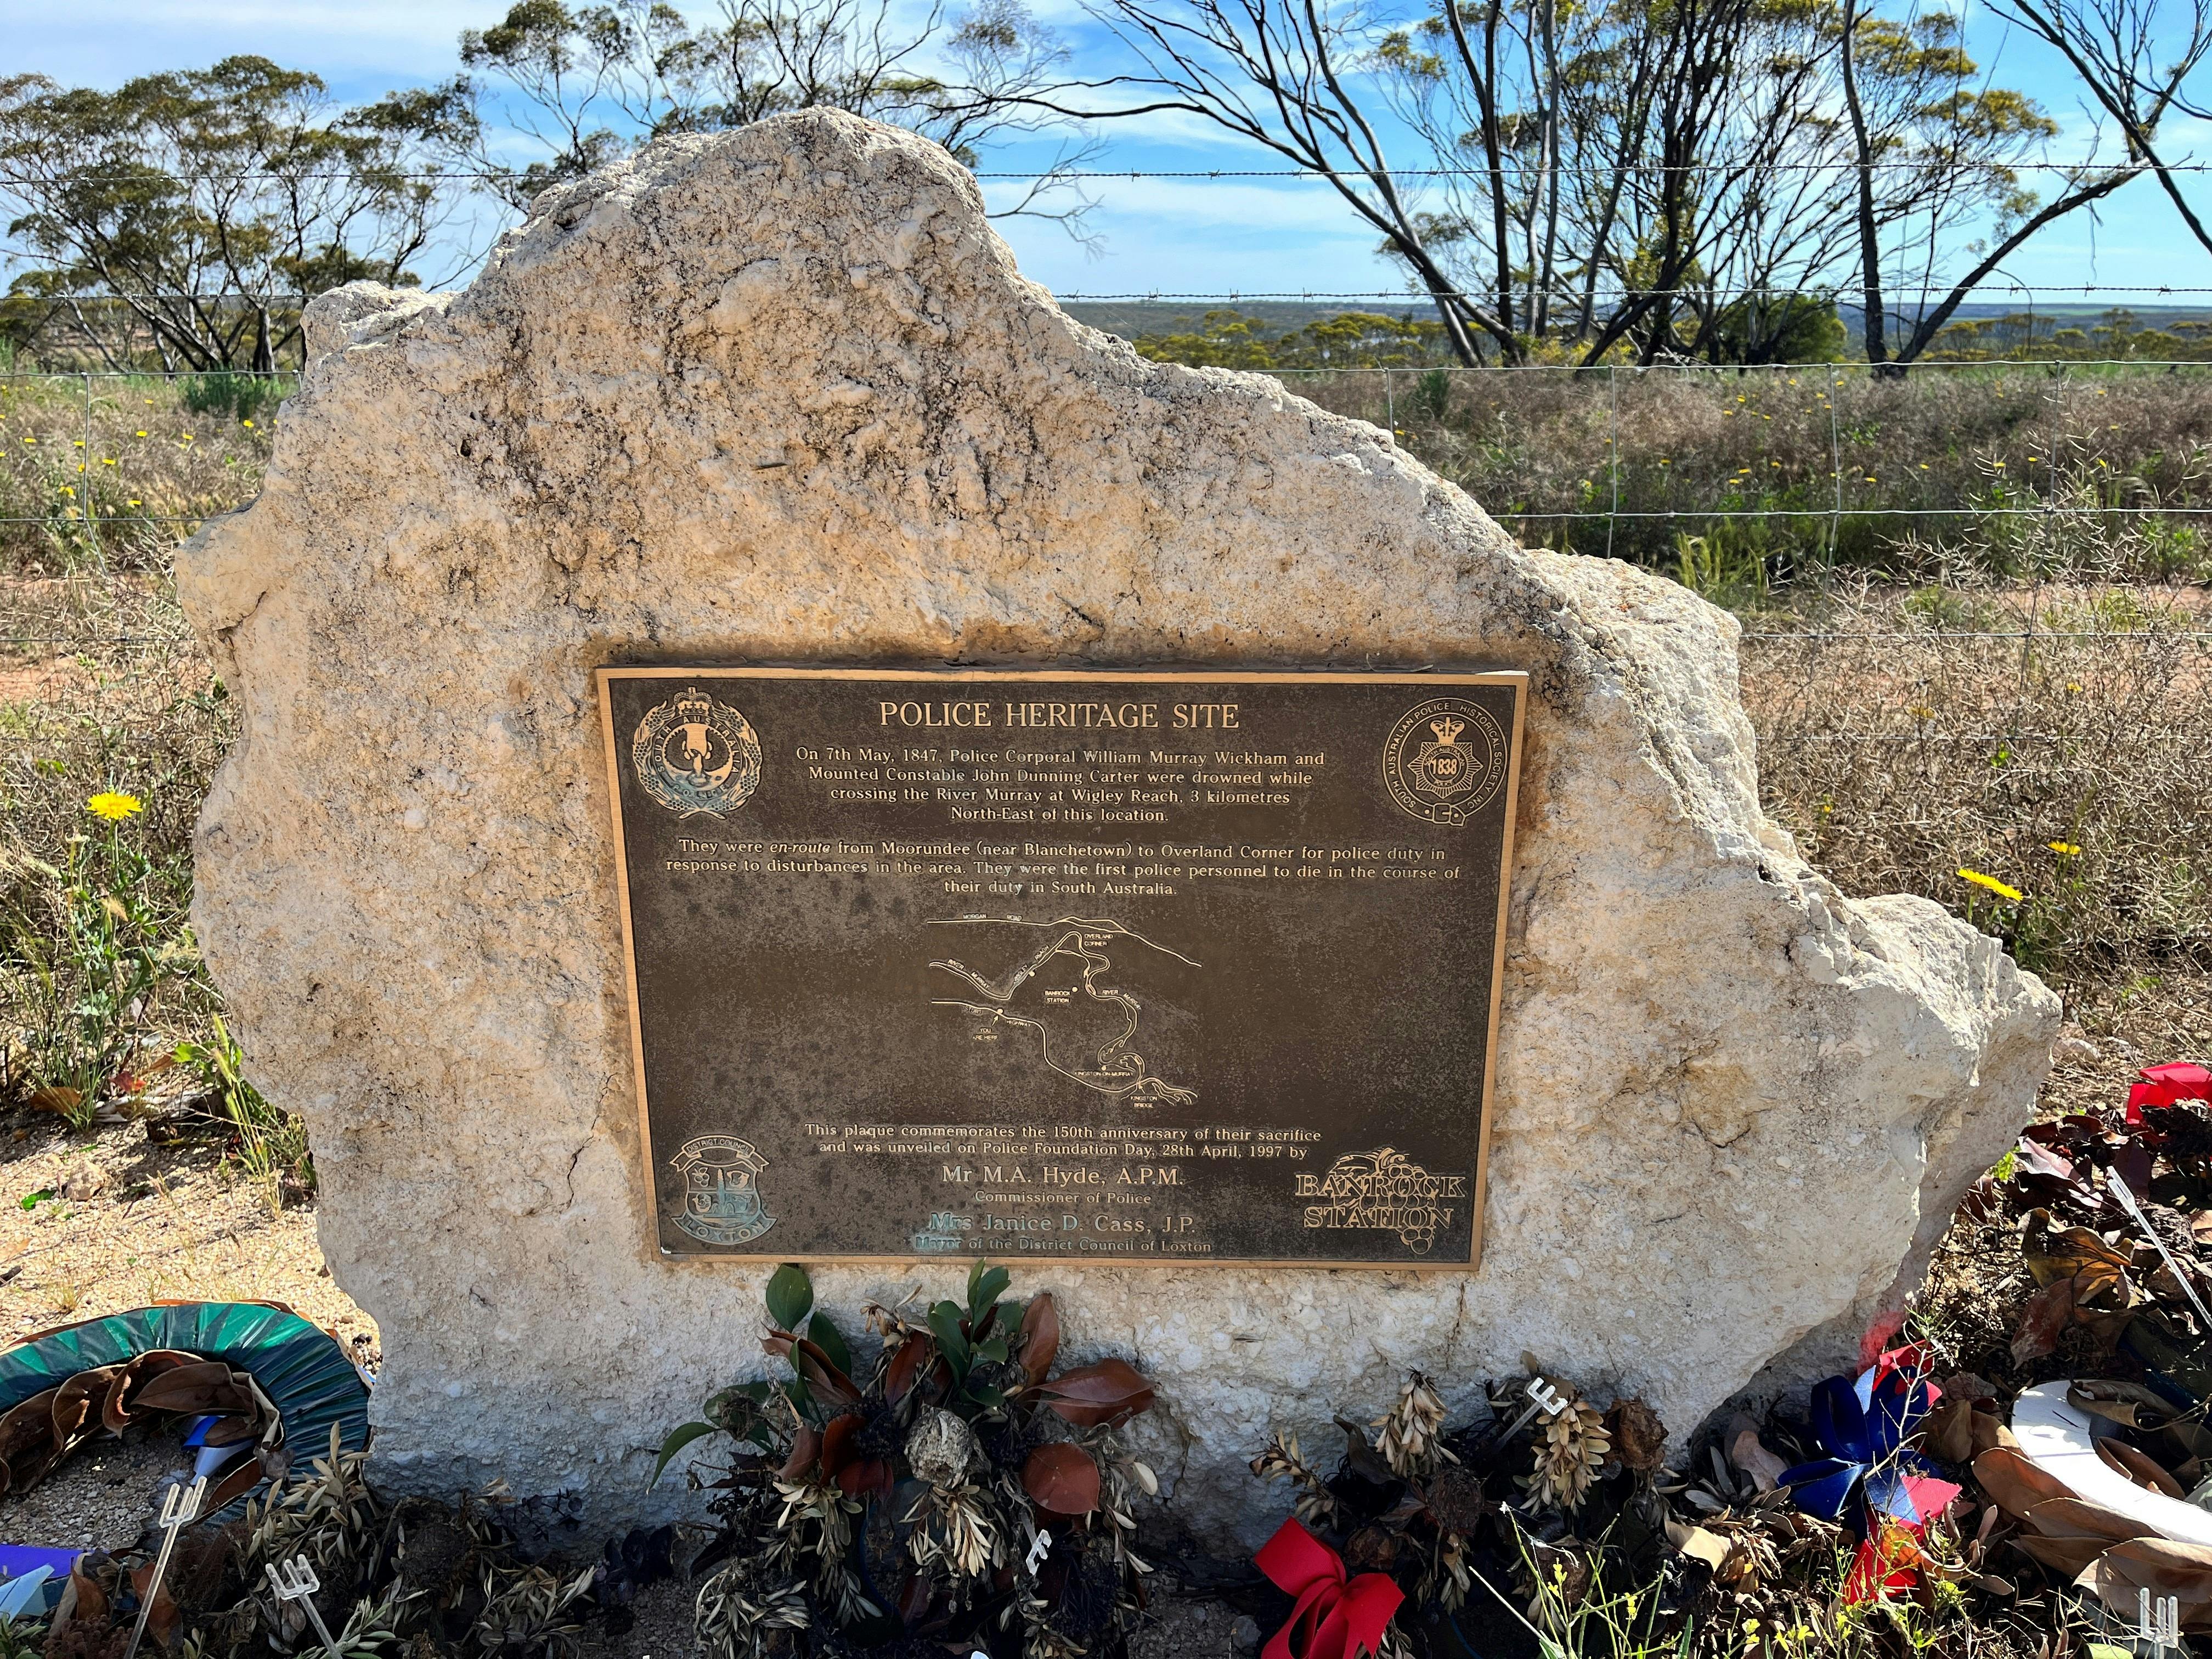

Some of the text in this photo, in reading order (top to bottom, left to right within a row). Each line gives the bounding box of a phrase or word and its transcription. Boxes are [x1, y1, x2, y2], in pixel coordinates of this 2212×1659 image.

[879, 702, 1239, 728] POLICE HERITAGE SITE
[654, 715, 741, 773] SOUTH AUSTRALIA
[796, 747, 1324, 767] On 7th May, 1847, Police Corporal William Murray Wickham and
[1388, 702, 1503, 809] SOUTH AUSTRALIAN POLICE HISTORICAL SOCIETY INC
[809, 766, 1312, 785] Mounted Constable John Dunning Carter were drowned while
[1431, 758, 1458, 775] 1838
[830, 787, 1290, 805] crossing the River Murray at Wigley Reach, 3 kilometres
[951, 806, 1169, 822] North-East of this location.
[678, 839, 1445, 863] They were en-route from Moorundee (near Blanchetown) to Overland Corner for police duty in
[666, 859, 1460, 879] response to disturbances in the area. They were the first police personnel to die in the course of
[945, 880, 1178, 895] their duty in South Australia.
[947, 959, 990, 989] RIVER MURRAY
[804, 1124, 1321, 1142] This plaque commemorates the 150th anniversary of their sacrifice
[686, 1138, 750, 1154] DISTRICT COUNCIL
[819, 1141, 1307, 1160] and was unveiled on Police Foundation Day, 28th April, 1997 by
[942, 1165, 1183, 1187] Mr M.A. Hyde, A.P.M.
[1294, 1174, 1466, 1198] BANROCK
[975, 1190, 1151, 1204] Commissioner of Police
[930, 1212, 1195, 1234] Mrs Janice D. Cass, J.P.
[1303, 1206, 1454, 1229] STATION
[684, 1218, 765, 1242] LOXTON
[915, 1235, 1211, 1252] Mayor of the District Council of Loxton
